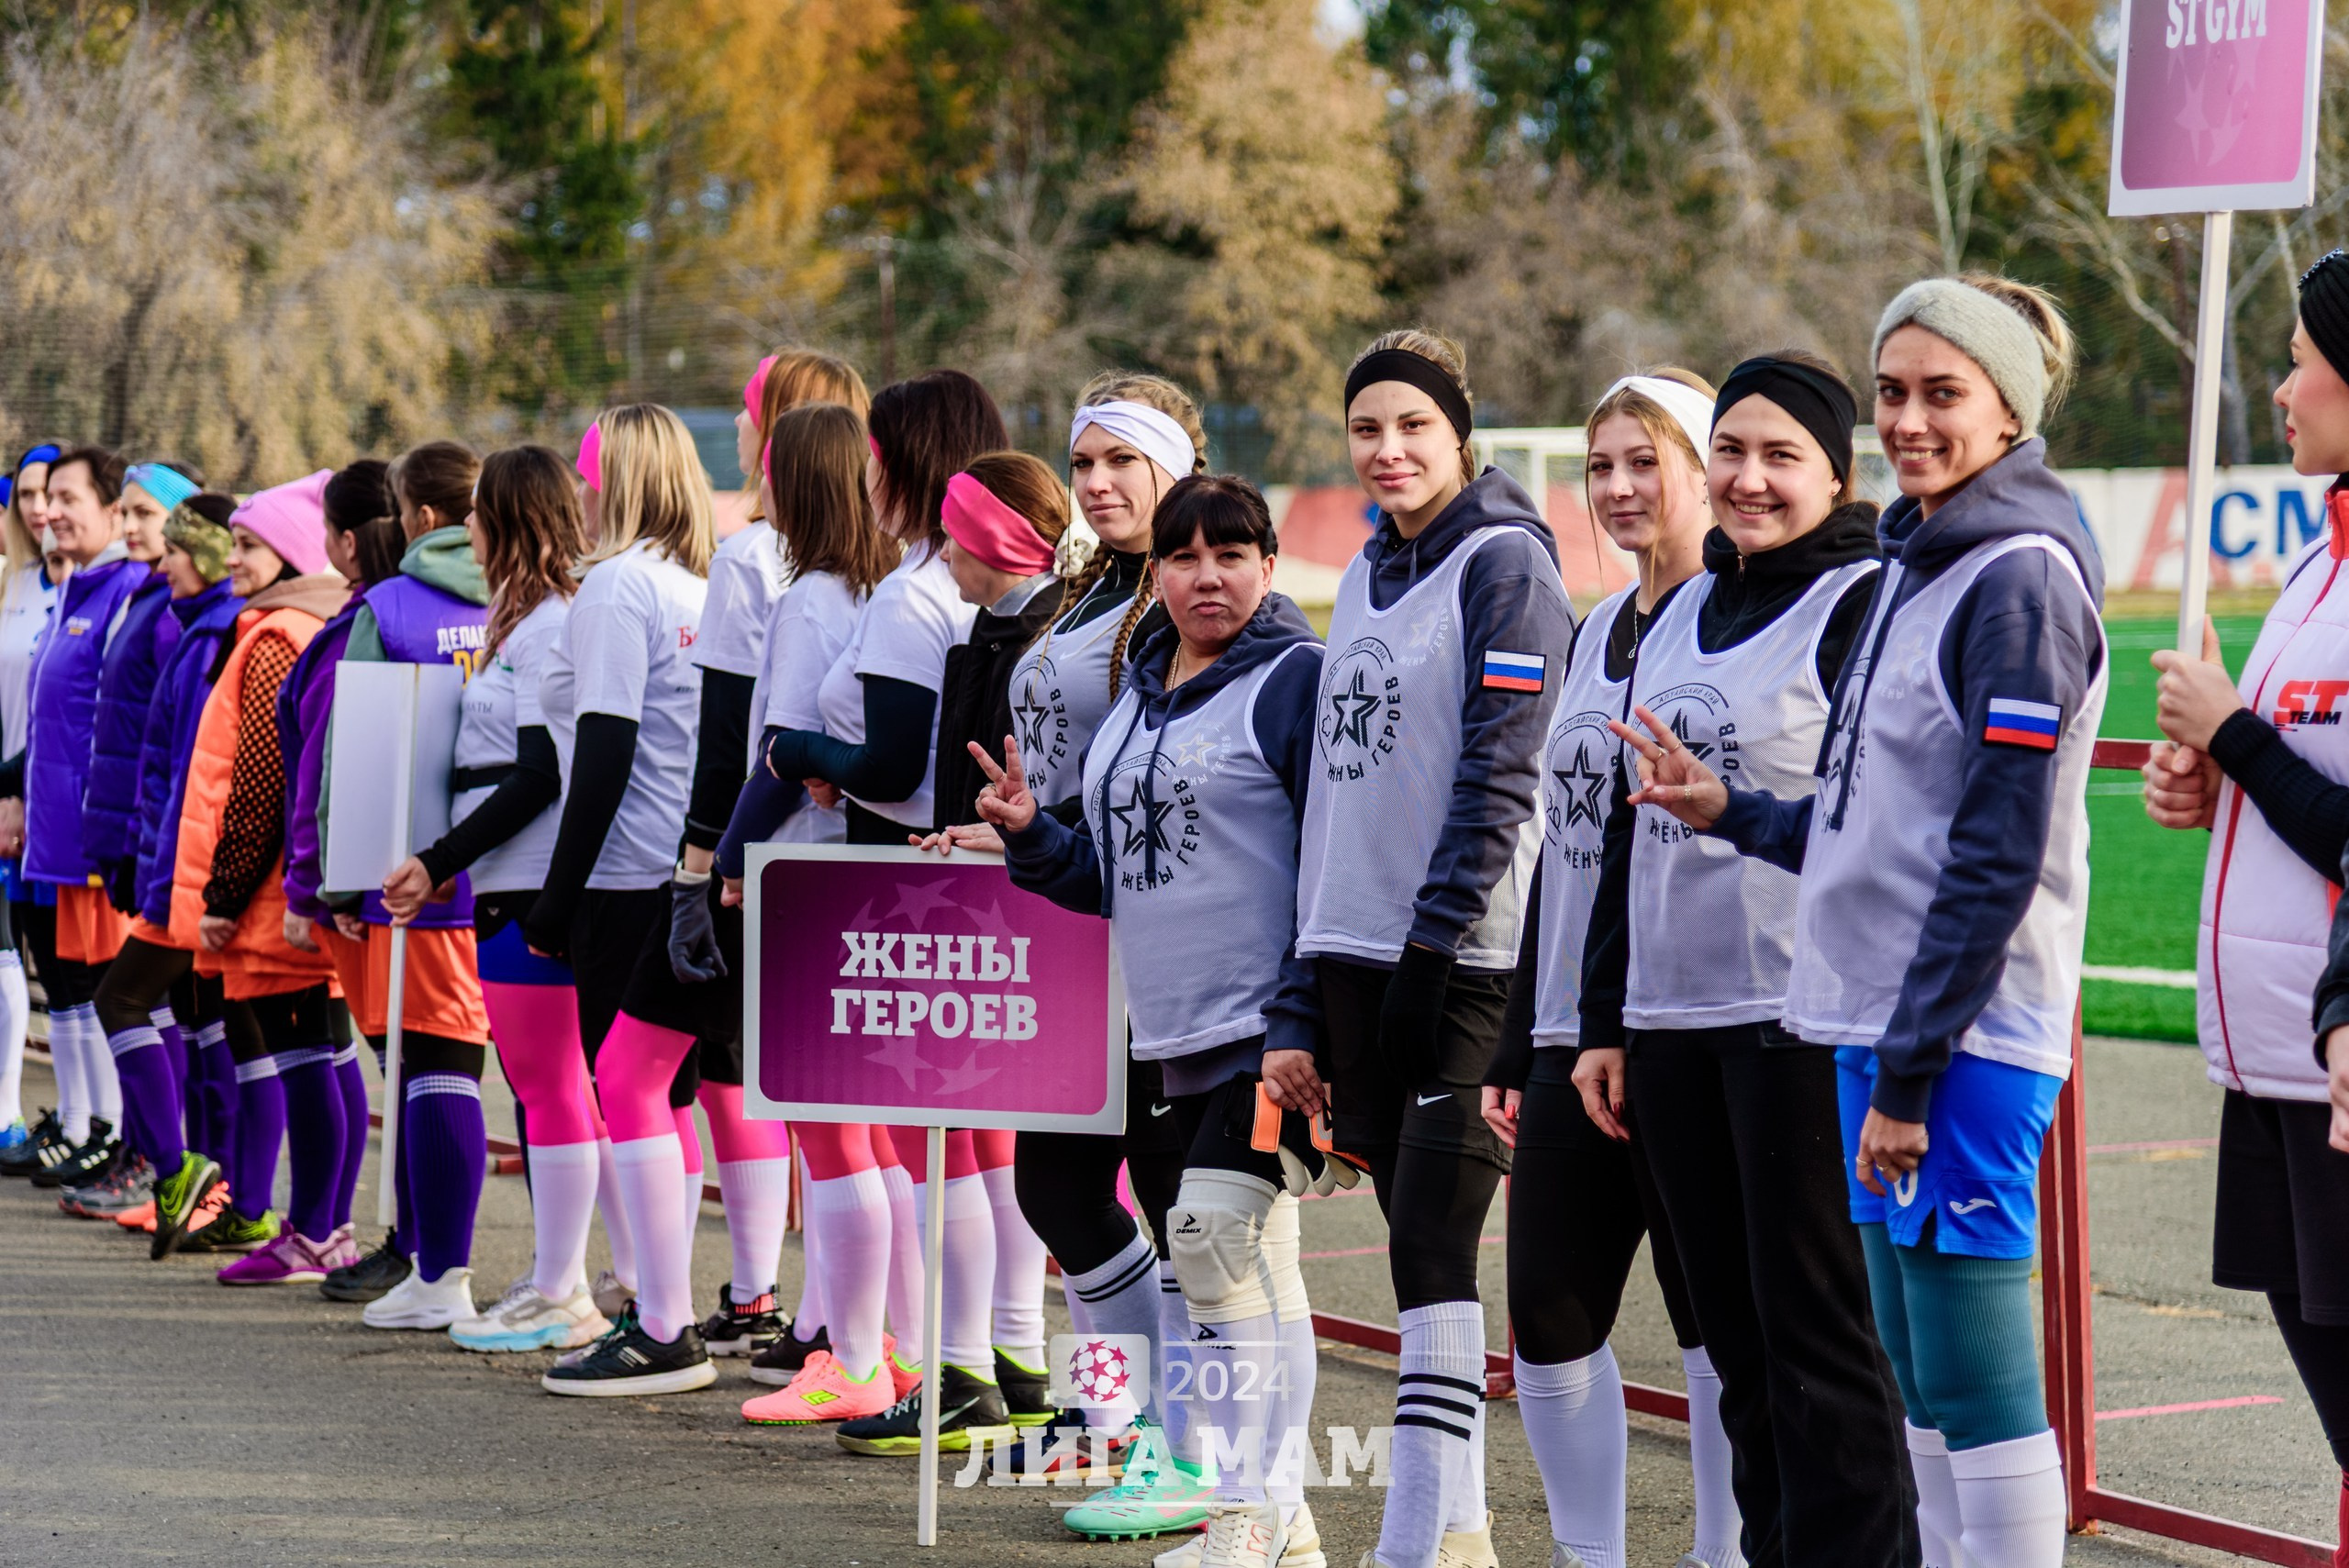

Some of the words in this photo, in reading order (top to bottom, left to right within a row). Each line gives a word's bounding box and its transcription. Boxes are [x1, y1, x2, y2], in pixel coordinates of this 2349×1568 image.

[1047, 688, 1069, 770] ГЕРОЕВ
[1371, 675, 1401, 766] ГЕРОЕВ
[2288, 710, 2342, 725] TEAM
[1174, 779, 1200, 865] ГЕРОЕВ
[840, 931, 1031, 983] ЖЕНЫ
[830, 988, 1039, 1040] ГЕРОЕВ
